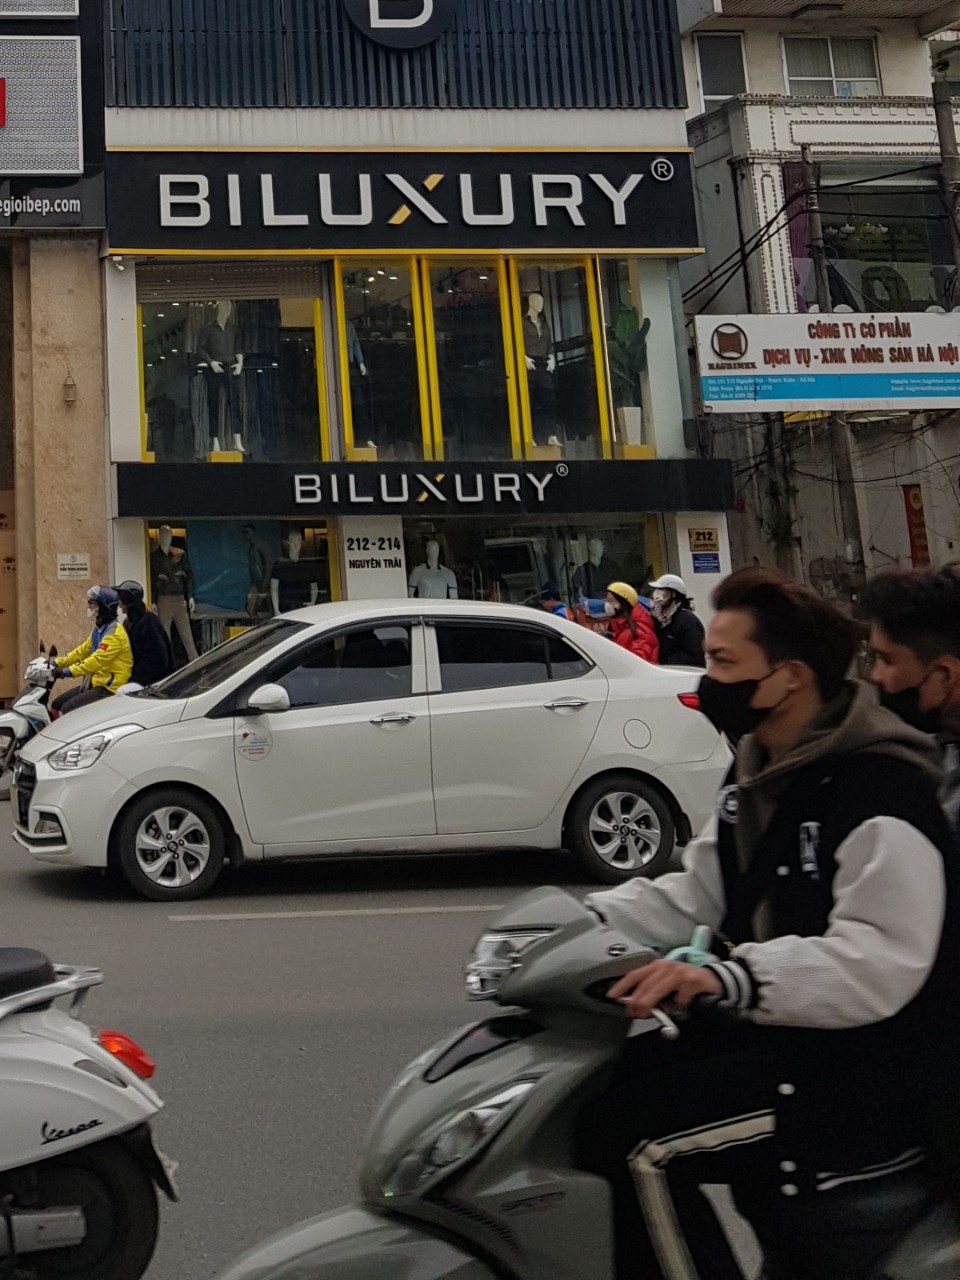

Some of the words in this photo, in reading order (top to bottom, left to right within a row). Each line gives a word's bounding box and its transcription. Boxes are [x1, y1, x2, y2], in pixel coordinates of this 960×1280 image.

[158, 173, 644, 228] BILUXURY
[807, 320, 841, 339] CÔNG
[879, 315, 912, 339] PHẦN
[762, 348, 791, 368] DỊCH
[794, 347, 812, 368] VỤ
[820, 347, 847, 364] XNK
[851, 344, 885, 364] NÔNG
[916, 343, 935, 363] HÀ
[937, 342, 959, 366] NỘI
[293, 472, 553, 505] BILUXURY
[695, 531, 713, 541] 212
